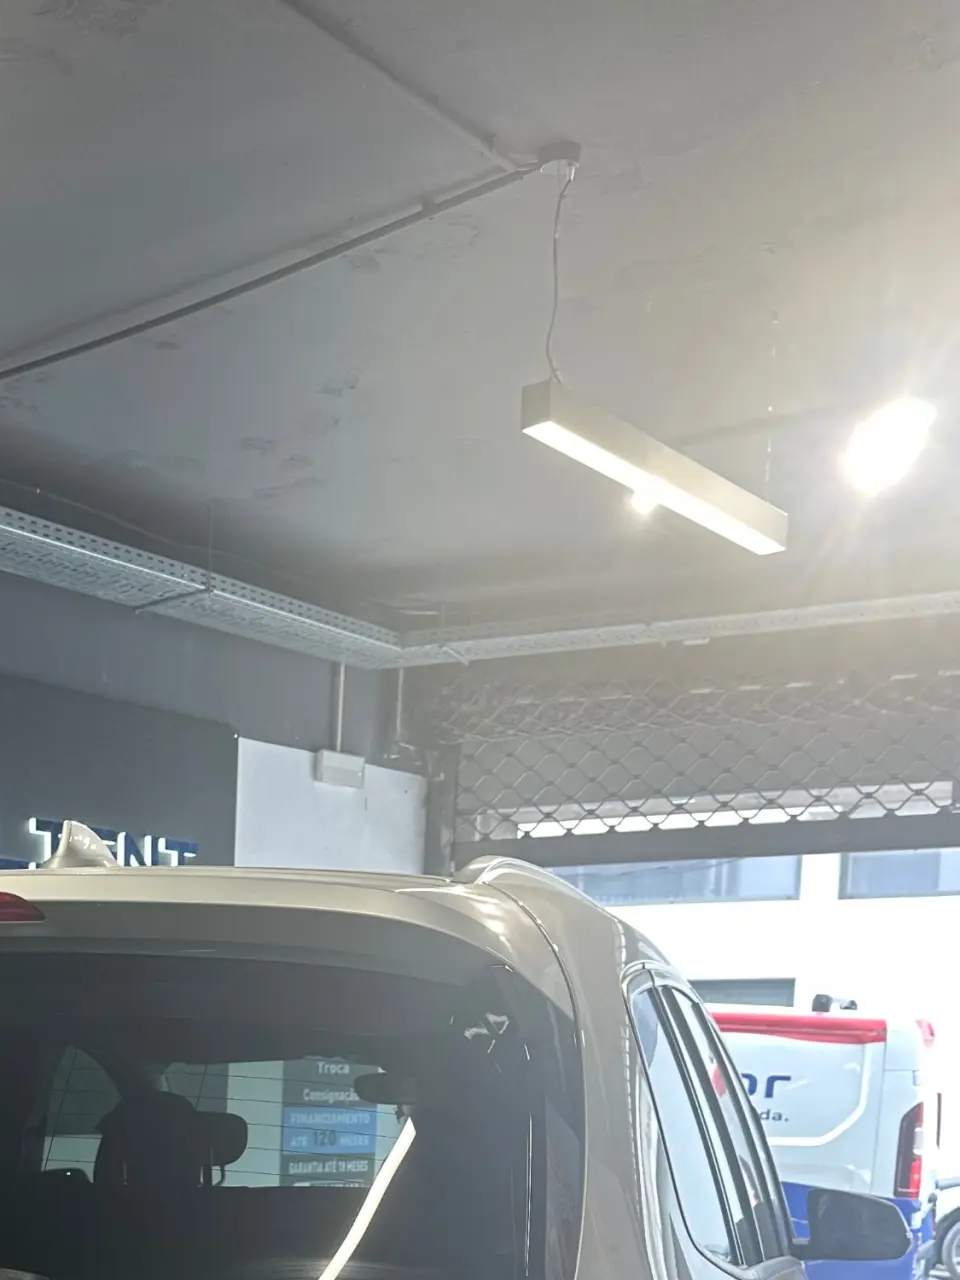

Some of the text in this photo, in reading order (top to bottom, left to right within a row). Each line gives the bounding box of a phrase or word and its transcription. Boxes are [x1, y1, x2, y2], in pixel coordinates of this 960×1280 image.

[317, 1061, 350, 1075] Troca
[291, 1111, 370, 1125] FINANCIAMENTO
[313, 1130, 337, 1147] 120
